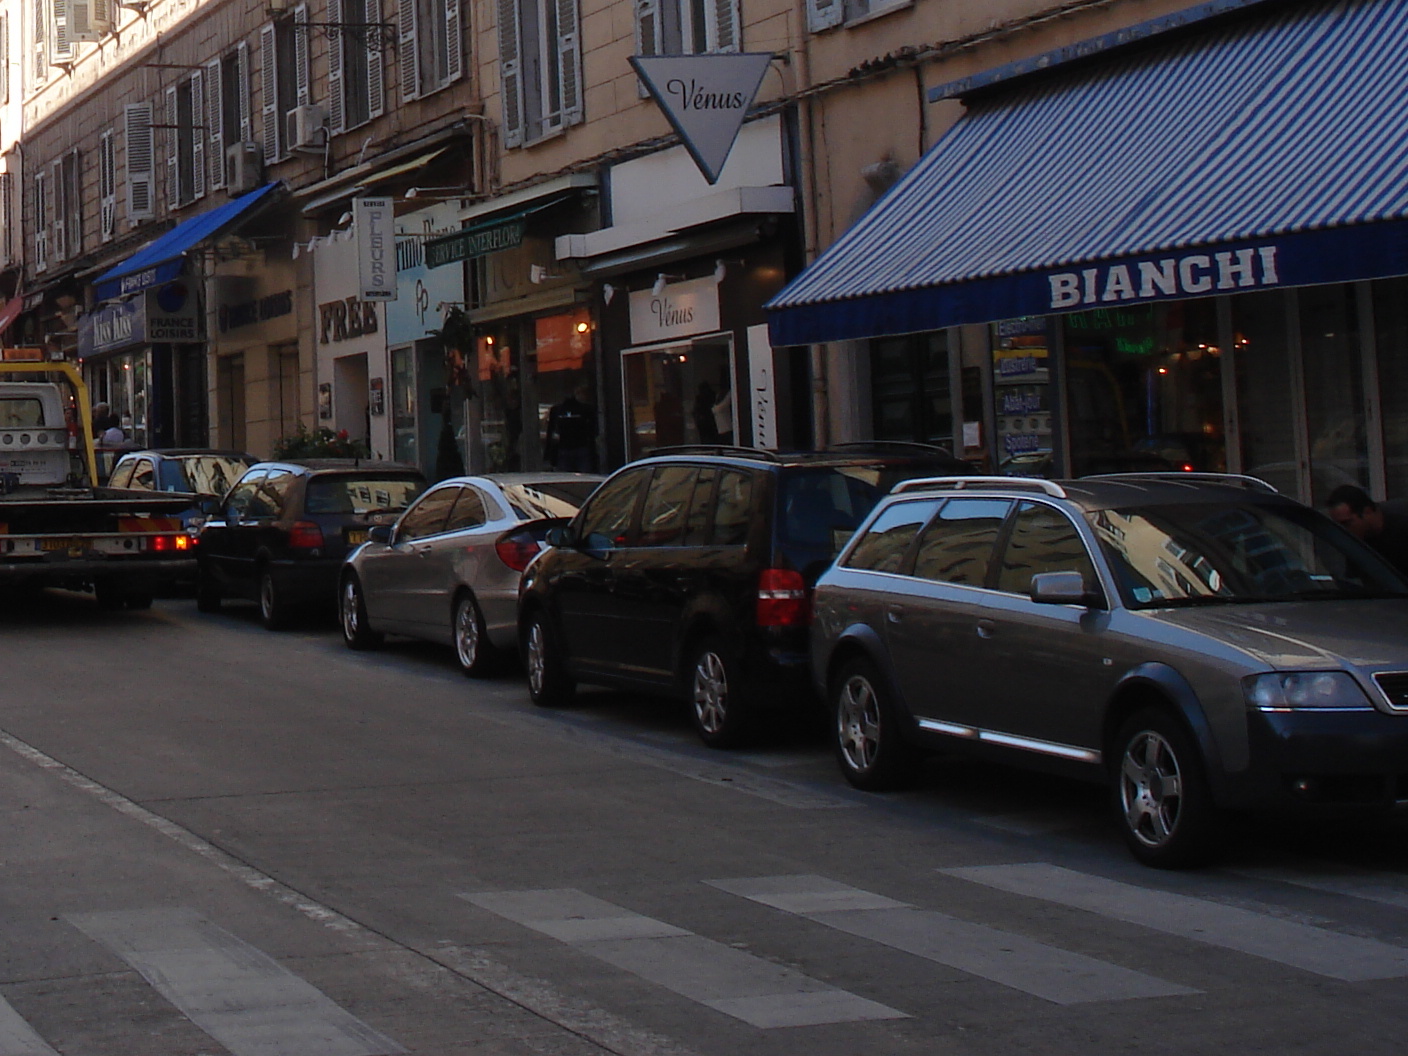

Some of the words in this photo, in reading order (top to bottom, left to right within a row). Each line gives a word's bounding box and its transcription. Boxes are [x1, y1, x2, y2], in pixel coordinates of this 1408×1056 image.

[667, 79, 746, 110] Vénus
[1048, 246, 1279, 309] BIANCHI
[150, 317, 194, 328] FRANCE
[319, 295, 377, 345] FREE
[650, 297, 693, 328] Vénus
[150, 328, 194, 339] LOISIRS
